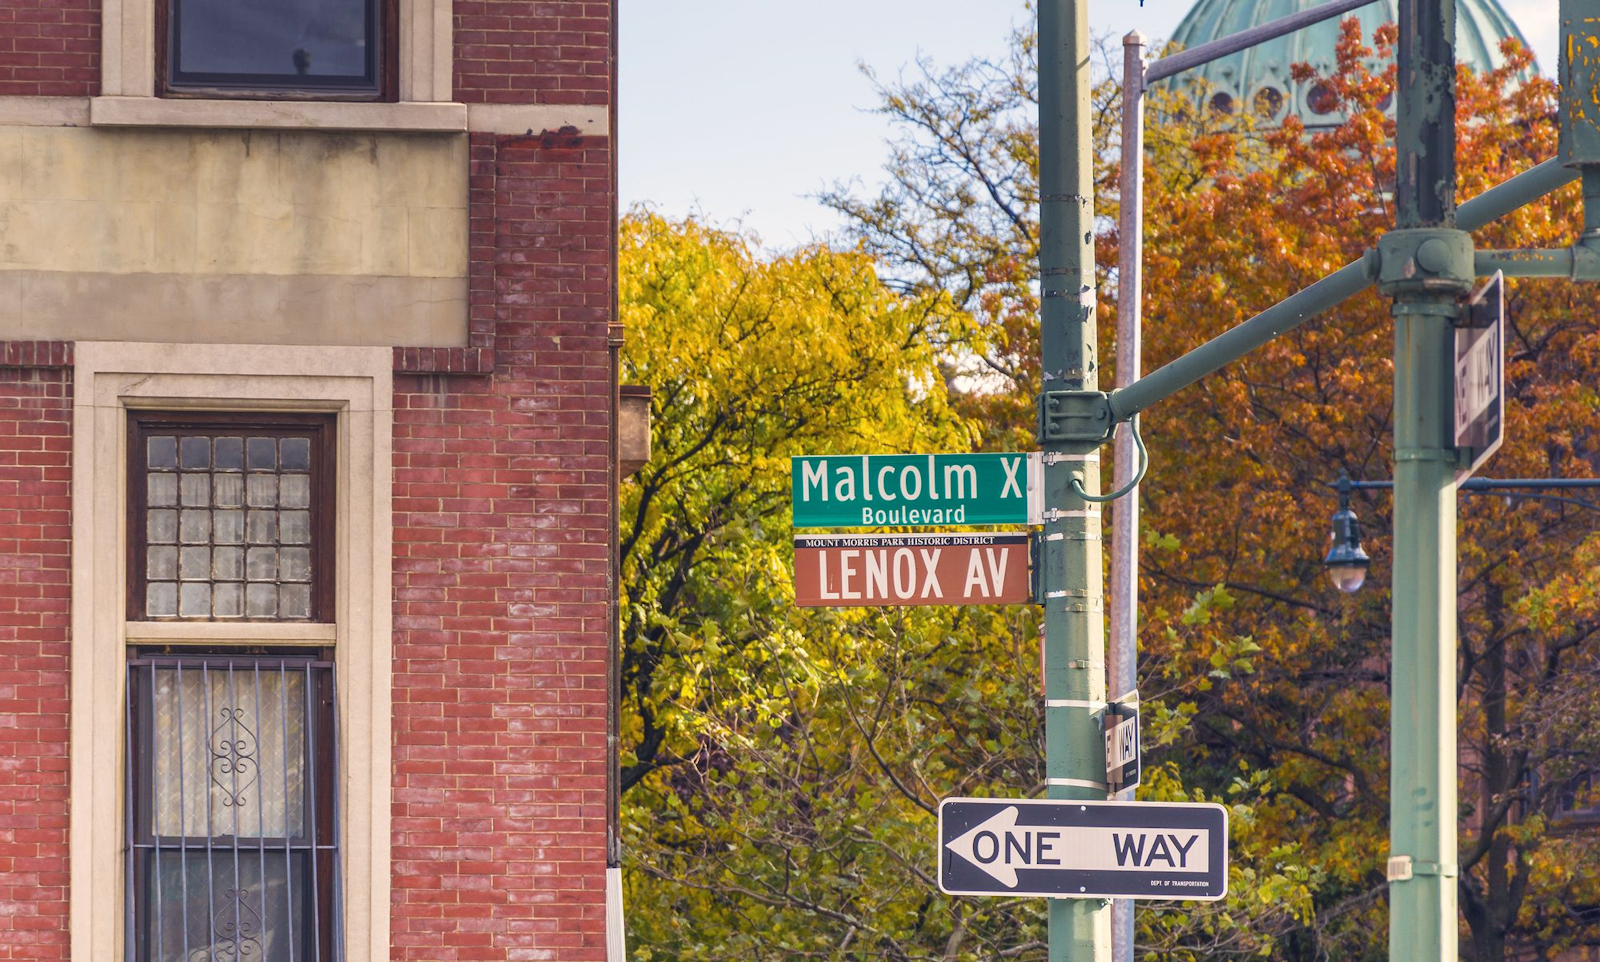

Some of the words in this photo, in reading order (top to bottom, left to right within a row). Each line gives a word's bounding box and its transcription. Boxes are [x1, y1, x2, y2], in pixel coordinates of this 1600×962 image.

[1476, 331, 1496, 408] WAY
[801, 455, 978, 502] Malcolm
[1000, 456, 1023, 499] X
[862, 504, 965, 525] Boulevard
[805, 538, 840, 547] MOUNT
[842, 538, 879, 547] MORRIS
[881, 538, 905, 546] PARK
[907, 537, 951, 546] HISTORIC
[953, 536, 995, 545] DISTRICT
[819, 547, 944, 600] LENOX
[963, 547, 1009, 598] AV
[1118, 722, 1135, 763] WAY
[972, 830, 1061, 866] ONE
[1112, 833, 1199, 868] WAY
